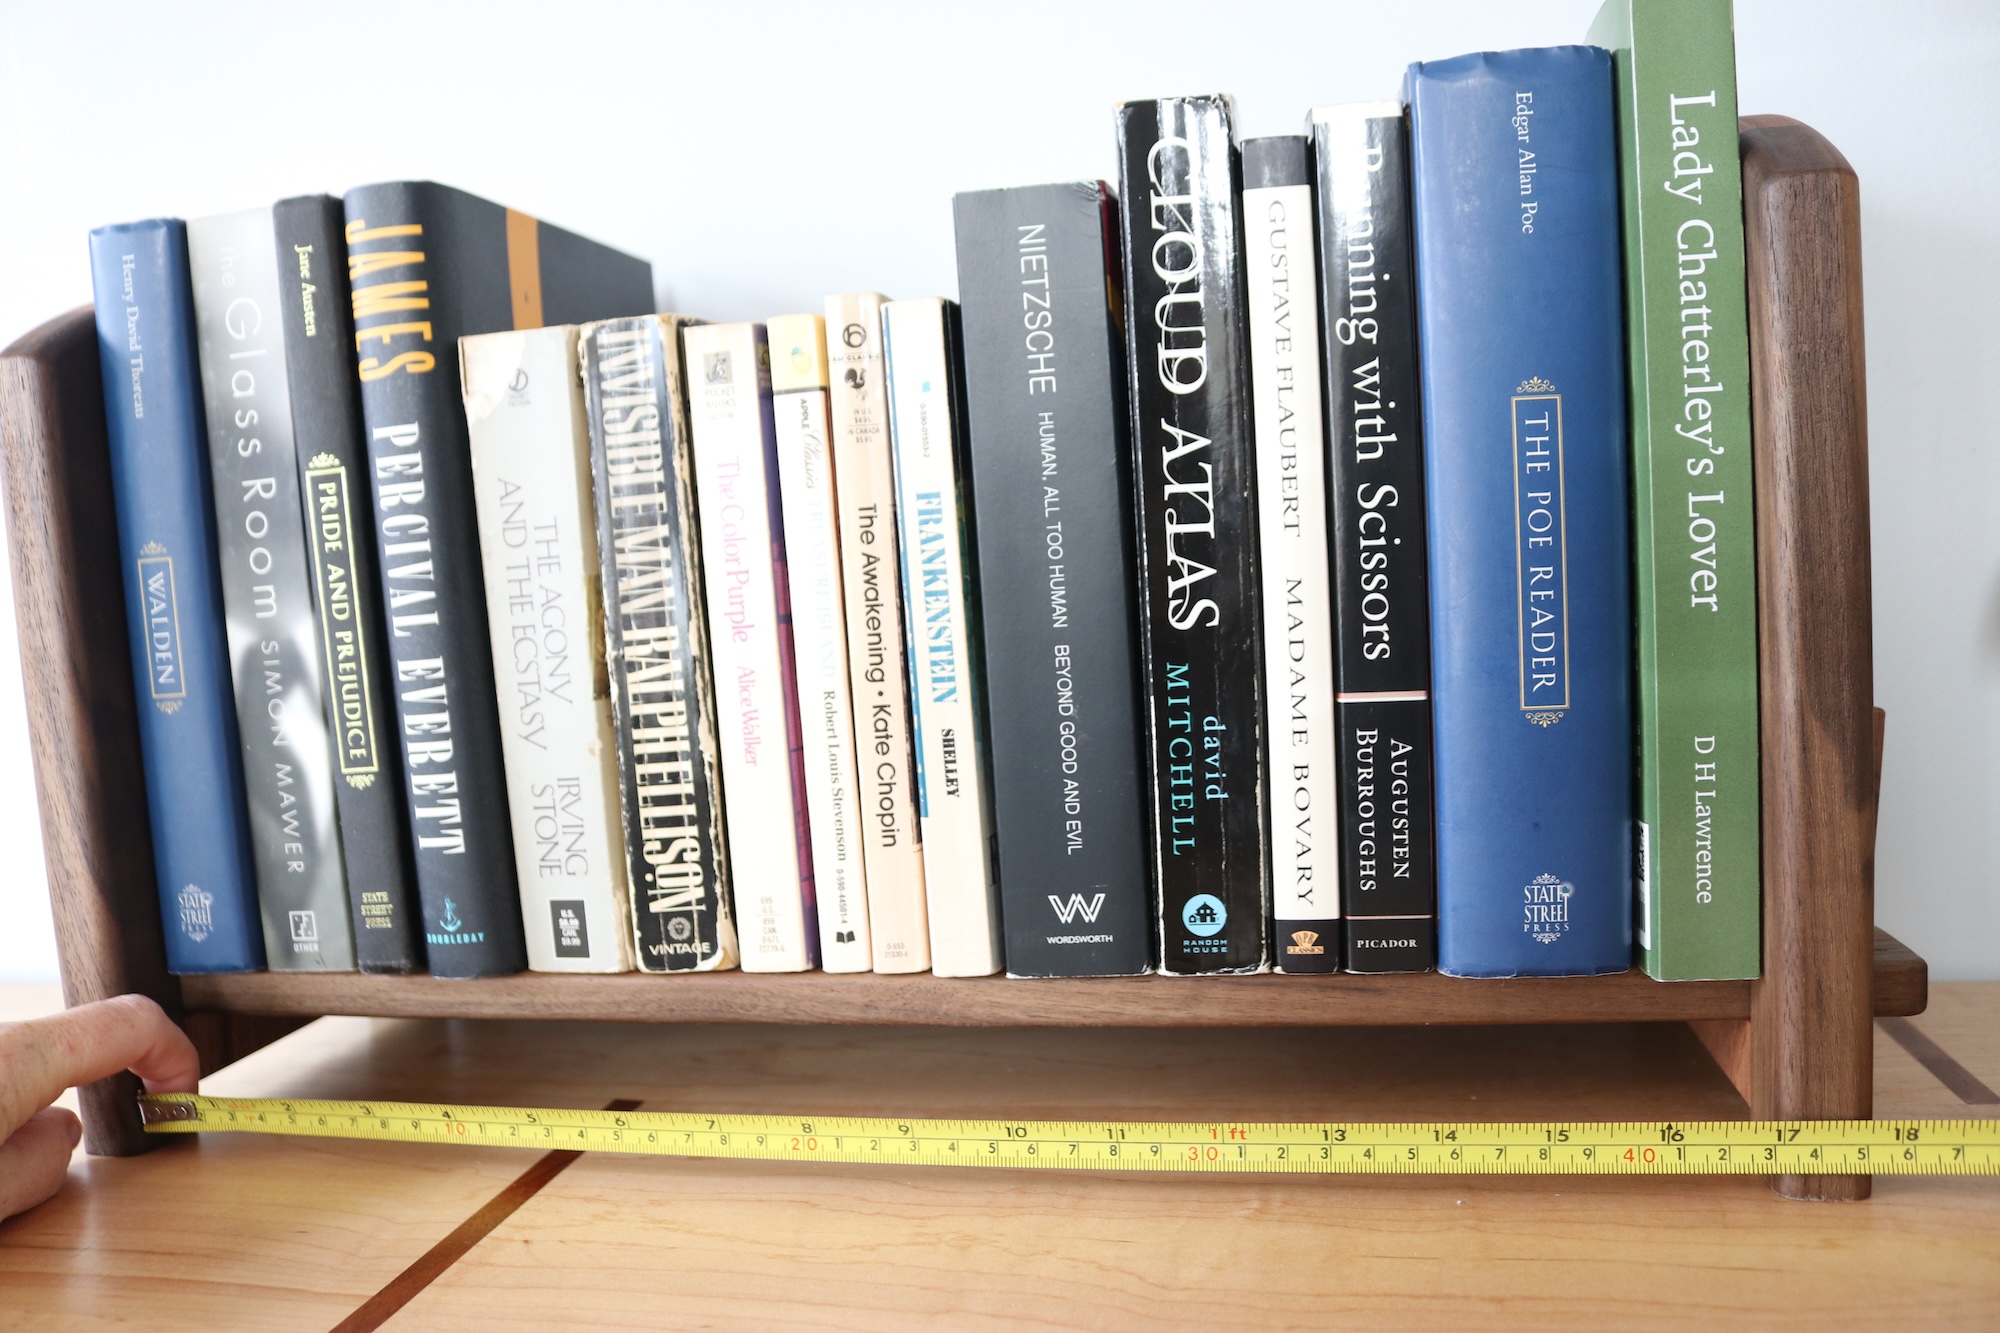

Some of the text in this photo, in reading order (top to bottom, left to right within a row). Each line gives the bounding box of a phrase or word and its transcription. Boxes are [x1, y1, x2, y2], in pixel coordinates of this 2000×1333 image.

[1511, 91, 1538, 235] Edgar Allan Poe
[121, 254, 144, 419] Henry David Thoreau
[294, 244, 317, 337] Jane Austen
[225, 296, 268, 459] Glass
[705, 387, 735, 396] POCKET
[1146, 135, 1221, 631] CLOUD ATLAS
[1663, 90, 1725, 613] Lady Chatterley's Lover
[800, 398, 810, 429] APPLE
[1351, 356, 1399, 464] with
[241, 477, 279, 620] Room
[345, 219, 466, 856] JAMES PERCIVAL EVERETT
[1017, 224, 1083, 855] NIETZSCHE HUMAN, ALL TOO HUMAN BEYOND GOOD AND EVIL
[1267, 200, 1314, 907] GUSTAVE FLAUBERT MADAME BOVARY
[1356, 482, 1402, 661] Scissors
[1524, 411, 1557, 693] THE POE READER
[147, 570, 176, 686] WALDEN
[317, 481, 368, 761] PRIDE AND PREJUDICE
[497, 478, 548, 751] AND THE ECSTASY
[534, 516, 574, 705] THE AGONY
[596, 329, 707, 914] INVISIBLE MAN RALPH ELLISON
[716, 456, 762, 767] The Color Purple Alice Walker
[915, 491, 960, 798] FRANKENSTEIN SHELLEY
[260, 640, 292, 747] SIMON
[823, 690, 838, 741] Robert
[857, 503, 901, 848] The Awakening Kate Chopin
[828, 744, 840, 784] Louis
[1165, 661, 1197, 856] MITCHELL
[1202, 715, 1229, 801] david
[1356, 728, 1379, 892] BURROUGHS
[1390, 738, 1414, 879] AUGUSTEN
[274, 763, 306, 874] MAWER
[531, 784, 563, 879] STONE
[556, 777, 589, 878] IRVING
[832, 788, 847, 862] Stevenson
[1694, 735, 1716, 904] D H Lawrence
[178, 892, 204, 908] STATE
[179, 906, 212, 926] STREET
[360, 904, 394, 917] STREET
[361, 891, 389, 904] STATE
[427, 931, 485, 945] DOUBLEDAY
[1047, 934, 1113, 945] WORDSWORTH
[1183, 938, 1228, 946] RANDOM
[1356, 938, 1418, 949] PICADOR
[1523, 885, 1564, 904] STATE
[1523, 901, 1569, 923] STREET
[1524, 923, 1570, 933] PRESS
[648, 942, 713, 956] VINTAGE
[1183, 946, 1228, 954] HOUSE
[197, 1111, 1961, 1163] 2 10 3 20 4 30 6 40 7
[281, 1102, 293, 1111] 2
[362, 1106, 372, 1116] 3
[442, 1111, 452, 1120] 4
[526, 1113, 537, 1123] 5
[615, 1117, 626, 1127] 6
[705, 1120, 715, 1130] 7
[801, 1123, 813, 1134] 8
[898, 1125, 910, 1136] 9
[1005, 1126, 1027, 1139] 10
[1106, 1128, 1126, 1140] 11
[1229, 1127, 1247, 1140] ft
[1321, 1129, 1347, 1142] 13
[1433, 1130, 1458, 1142] 14
[1545, 1129, 1570, 1142] 15
[1660, 1129, 1685, 1142] 16
[1775, 1128, 1801, 1142] 17
[1894, 1128, 1919, 1141] 18
